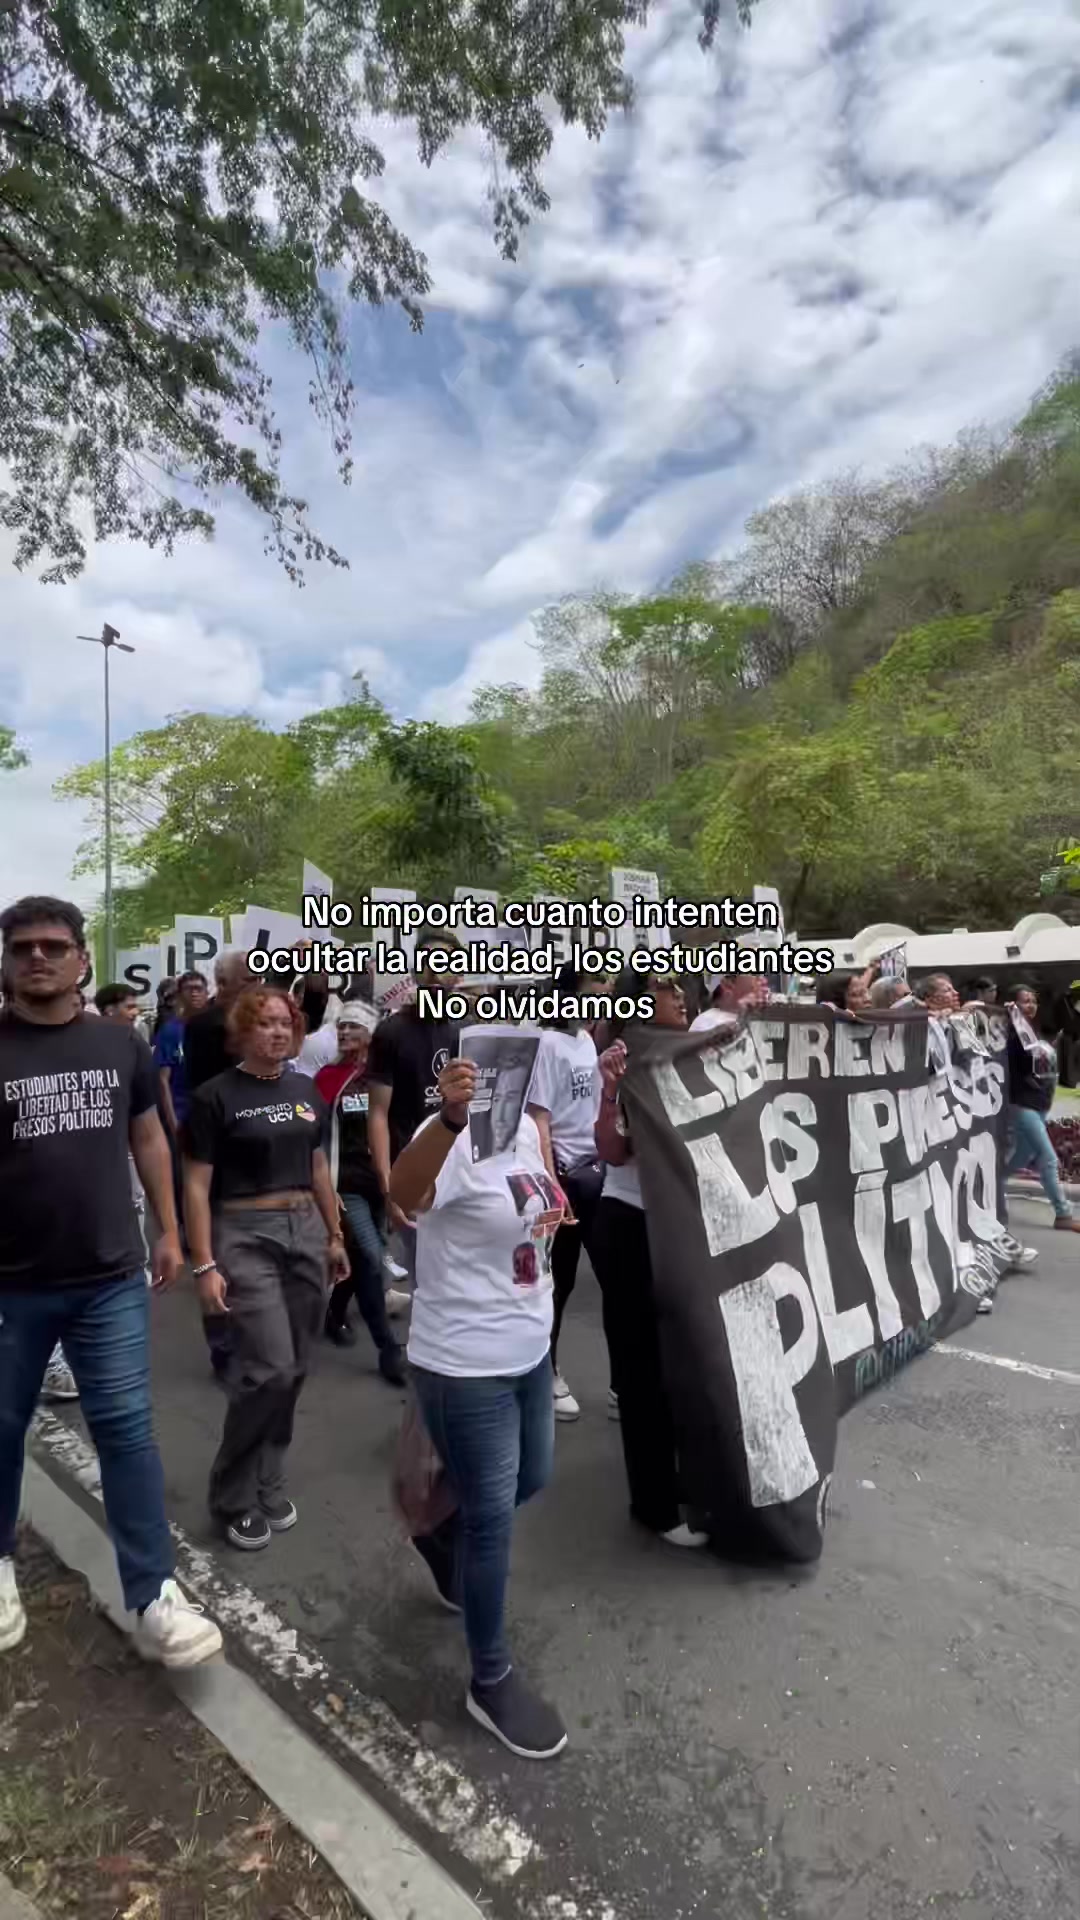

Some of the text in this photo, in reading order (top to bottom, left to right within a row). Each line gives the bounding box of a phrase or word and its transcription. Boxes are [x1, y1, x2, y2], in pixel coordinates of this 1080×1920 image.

[4, 1068, 120, 1102] ESTUDIANTES POR LA
[19, 1089, 111, 1119] LIBERTAD DE LOS
[268, 1111, 293, 1124] UCV
[847, 1060, 1005, 1166] PRESS
